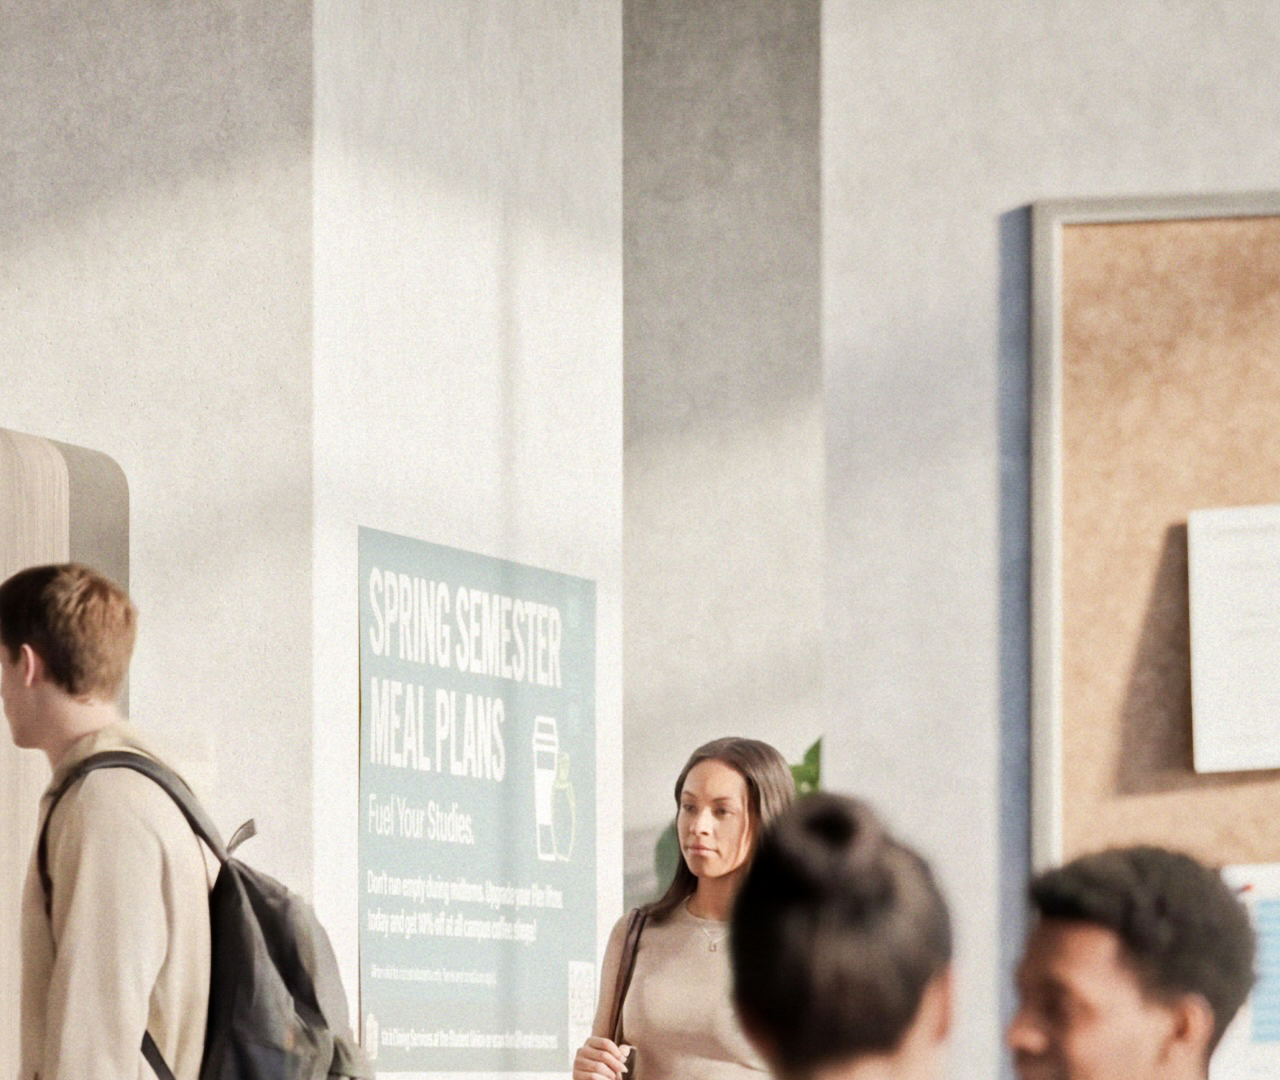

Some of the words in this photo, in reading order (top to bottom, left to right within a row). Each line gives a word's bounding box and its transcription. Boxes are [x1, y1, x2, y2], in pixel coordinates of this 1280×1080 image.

[368, 566, 450, 669] SPRING
[455, 586, 563, 689] SEMESTER
[370, 677, 431, 773] MEAL
[436, 687, 507, 783] PLANS
[368, 794, 394, 833] Fuel
[396, 798, 425, 839] Your
[427, 803, 475, 846] Studies.
